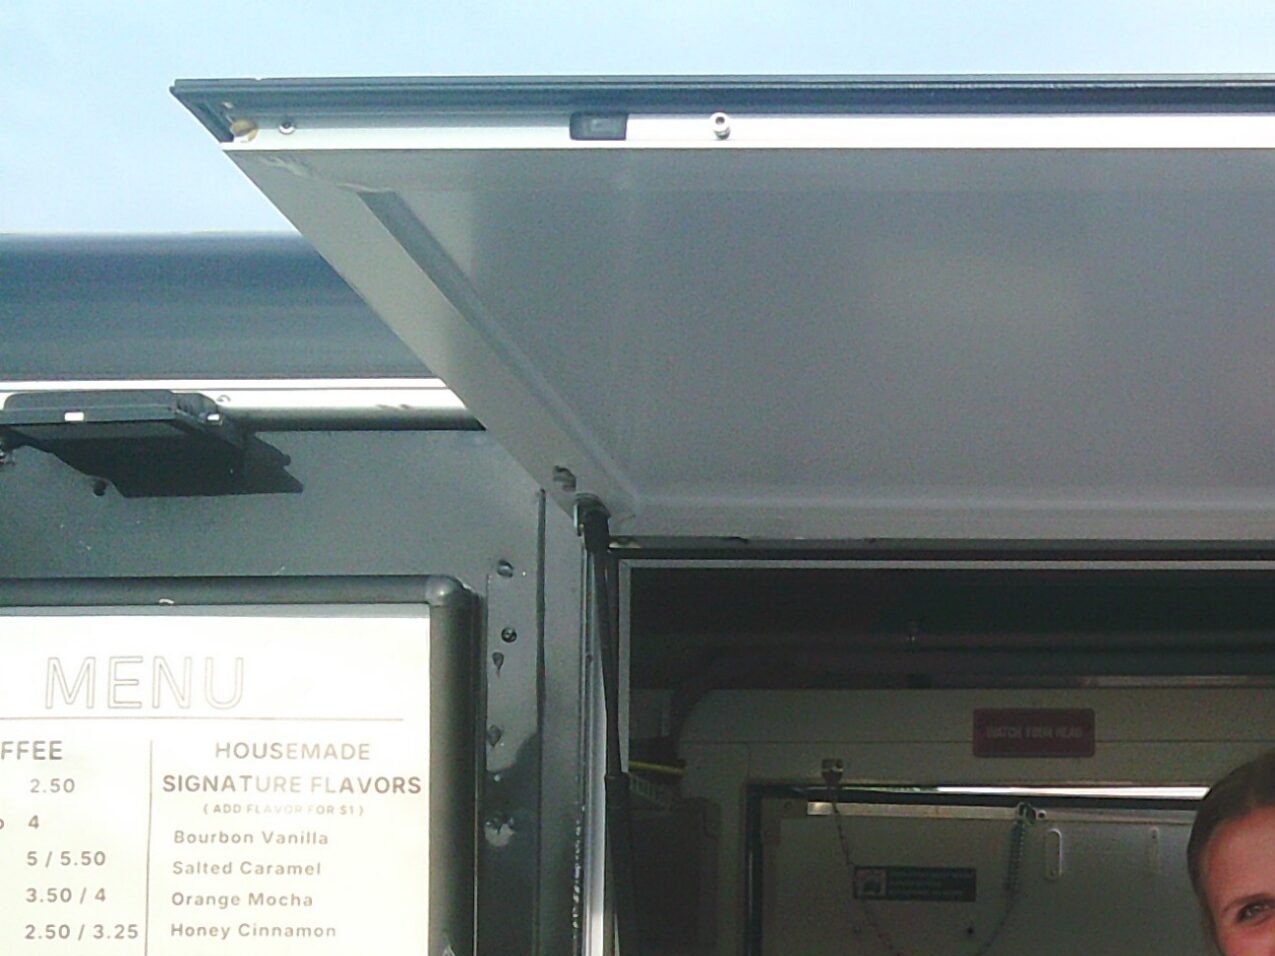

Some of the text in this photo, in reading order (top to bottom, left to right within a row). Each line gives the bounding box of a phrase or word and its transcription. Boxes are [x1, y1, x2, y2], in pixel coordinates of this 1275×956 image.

[45, 655, 244, 710] MENU
[216, 742, 369, 760] HOUSEMADE
[30, 778, 75, 793] 2.50
[163, 775, 421, 794] SIGNATURE FLAVORS
[213, 803, 241, 814] ADD
[28, 815, 39, 829] 4
[174, 830, 328, 845] Bourbon Vanilla
[27, 851, 38, 866] 5
[60, 851, 106, 866] 5.50
[173, 861, 320, 875] Salted Caramel
[26, 888, 72, 903] 3.50
[95, 888, 106, 902] 4
[172, 892, 312, 909] Orange Mocha
[25, 924, 70, 939] 2.50
[93, 924, 138, 939] 3.25
[171, 923, 336, 940] Honey Cinnamon
